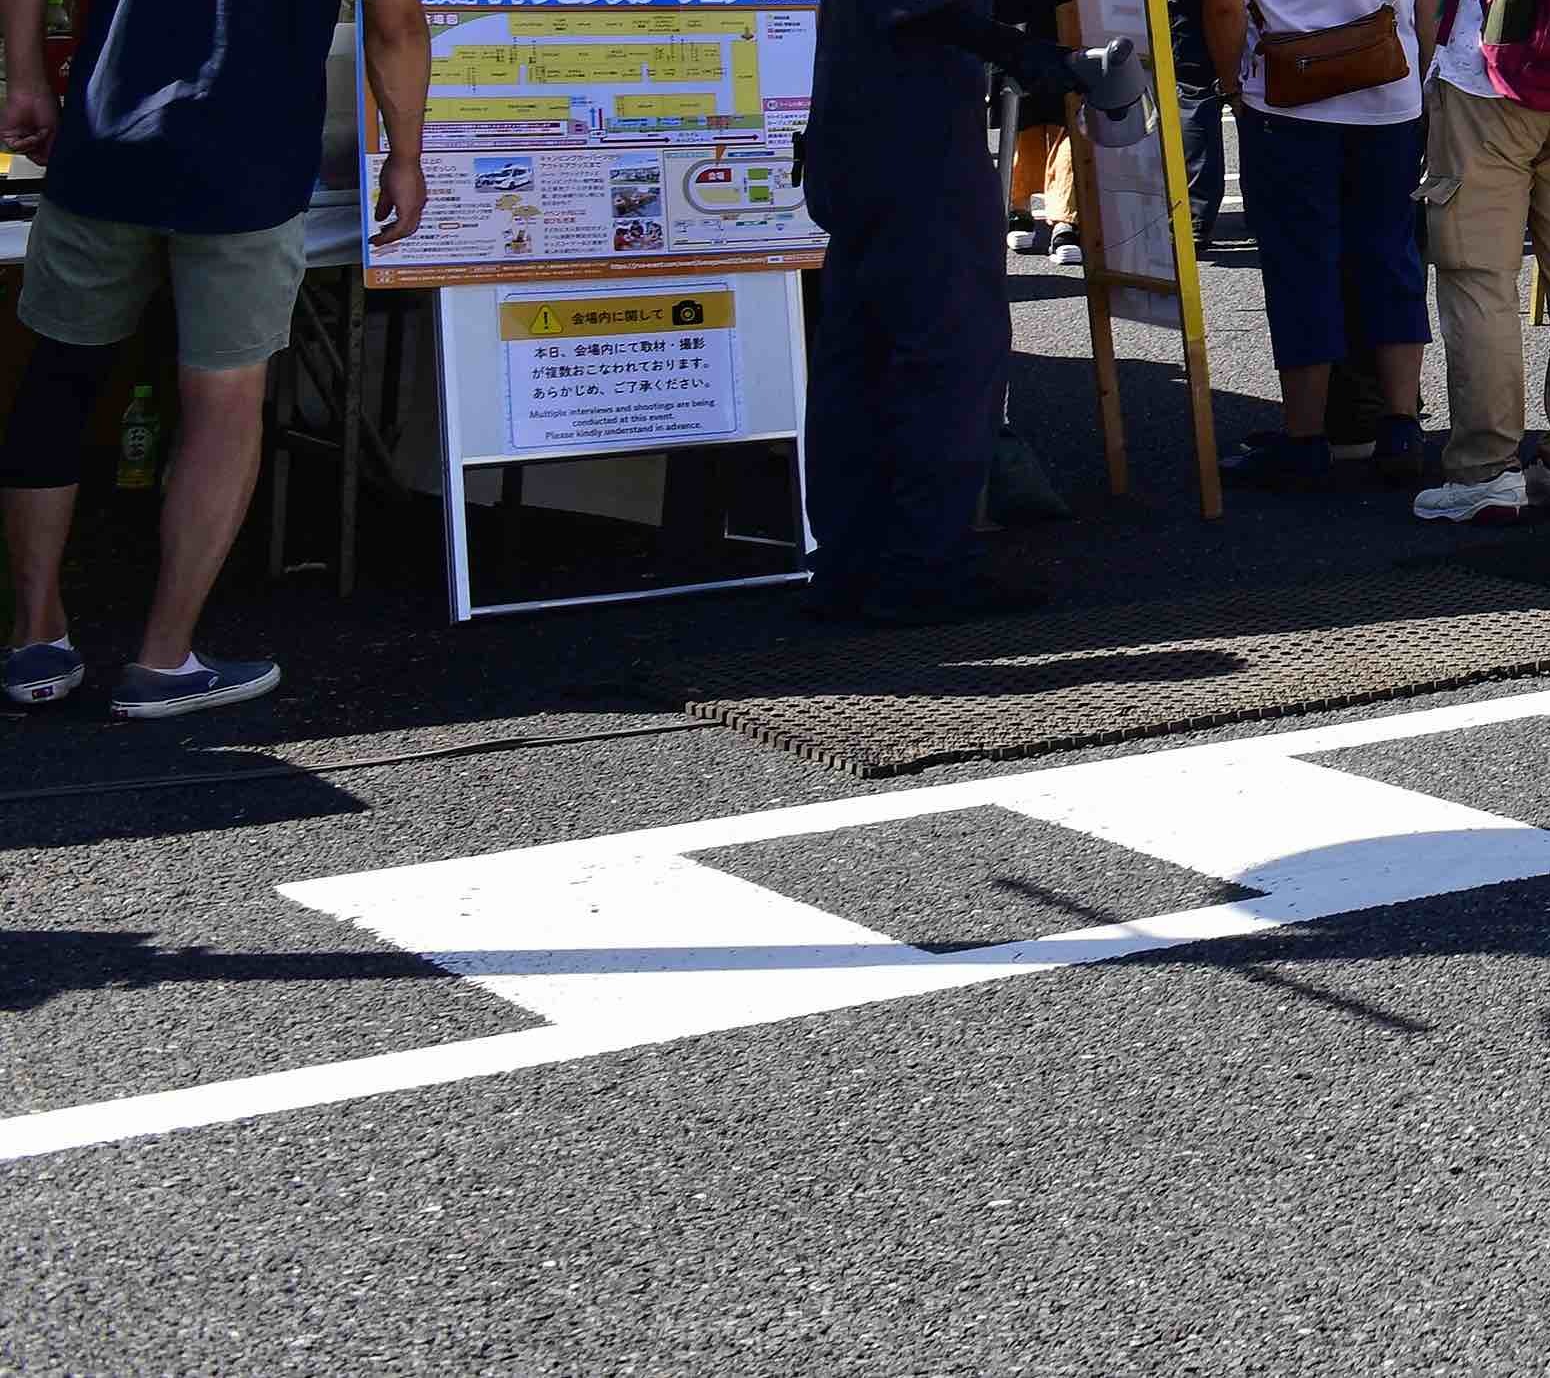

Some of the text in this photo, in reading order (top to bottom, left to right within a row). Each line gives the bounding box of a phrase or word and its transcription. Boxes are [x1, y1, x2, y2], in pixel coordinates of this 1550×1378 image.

[571, 308, 665, 326] 会場内に関して
[534, 337, 706, 359] 本日、会場内にて取材・撮影
[532, 357, 711, 381] が複数おこなわれております。
[532, 379, 711, 400] あらかじめ、ご了承ください。
[529, 408, 567, 419] Multiple
[569, 405, 613, 417] interviews
[616, 403, 632, 413] and
[633, 401, 675, 414] shootings
[691, 398, 715, 411] being
[572, 416, 620, 428] conducted
[631, 413, 647, 423] this
[649, 412, 675, 422] event.
[545, 429, 575, 441] Please
[576, 428, 602, 441] kindly
[603, 424, 654, 437] understand
[665, 421, 702, 431] advance.
